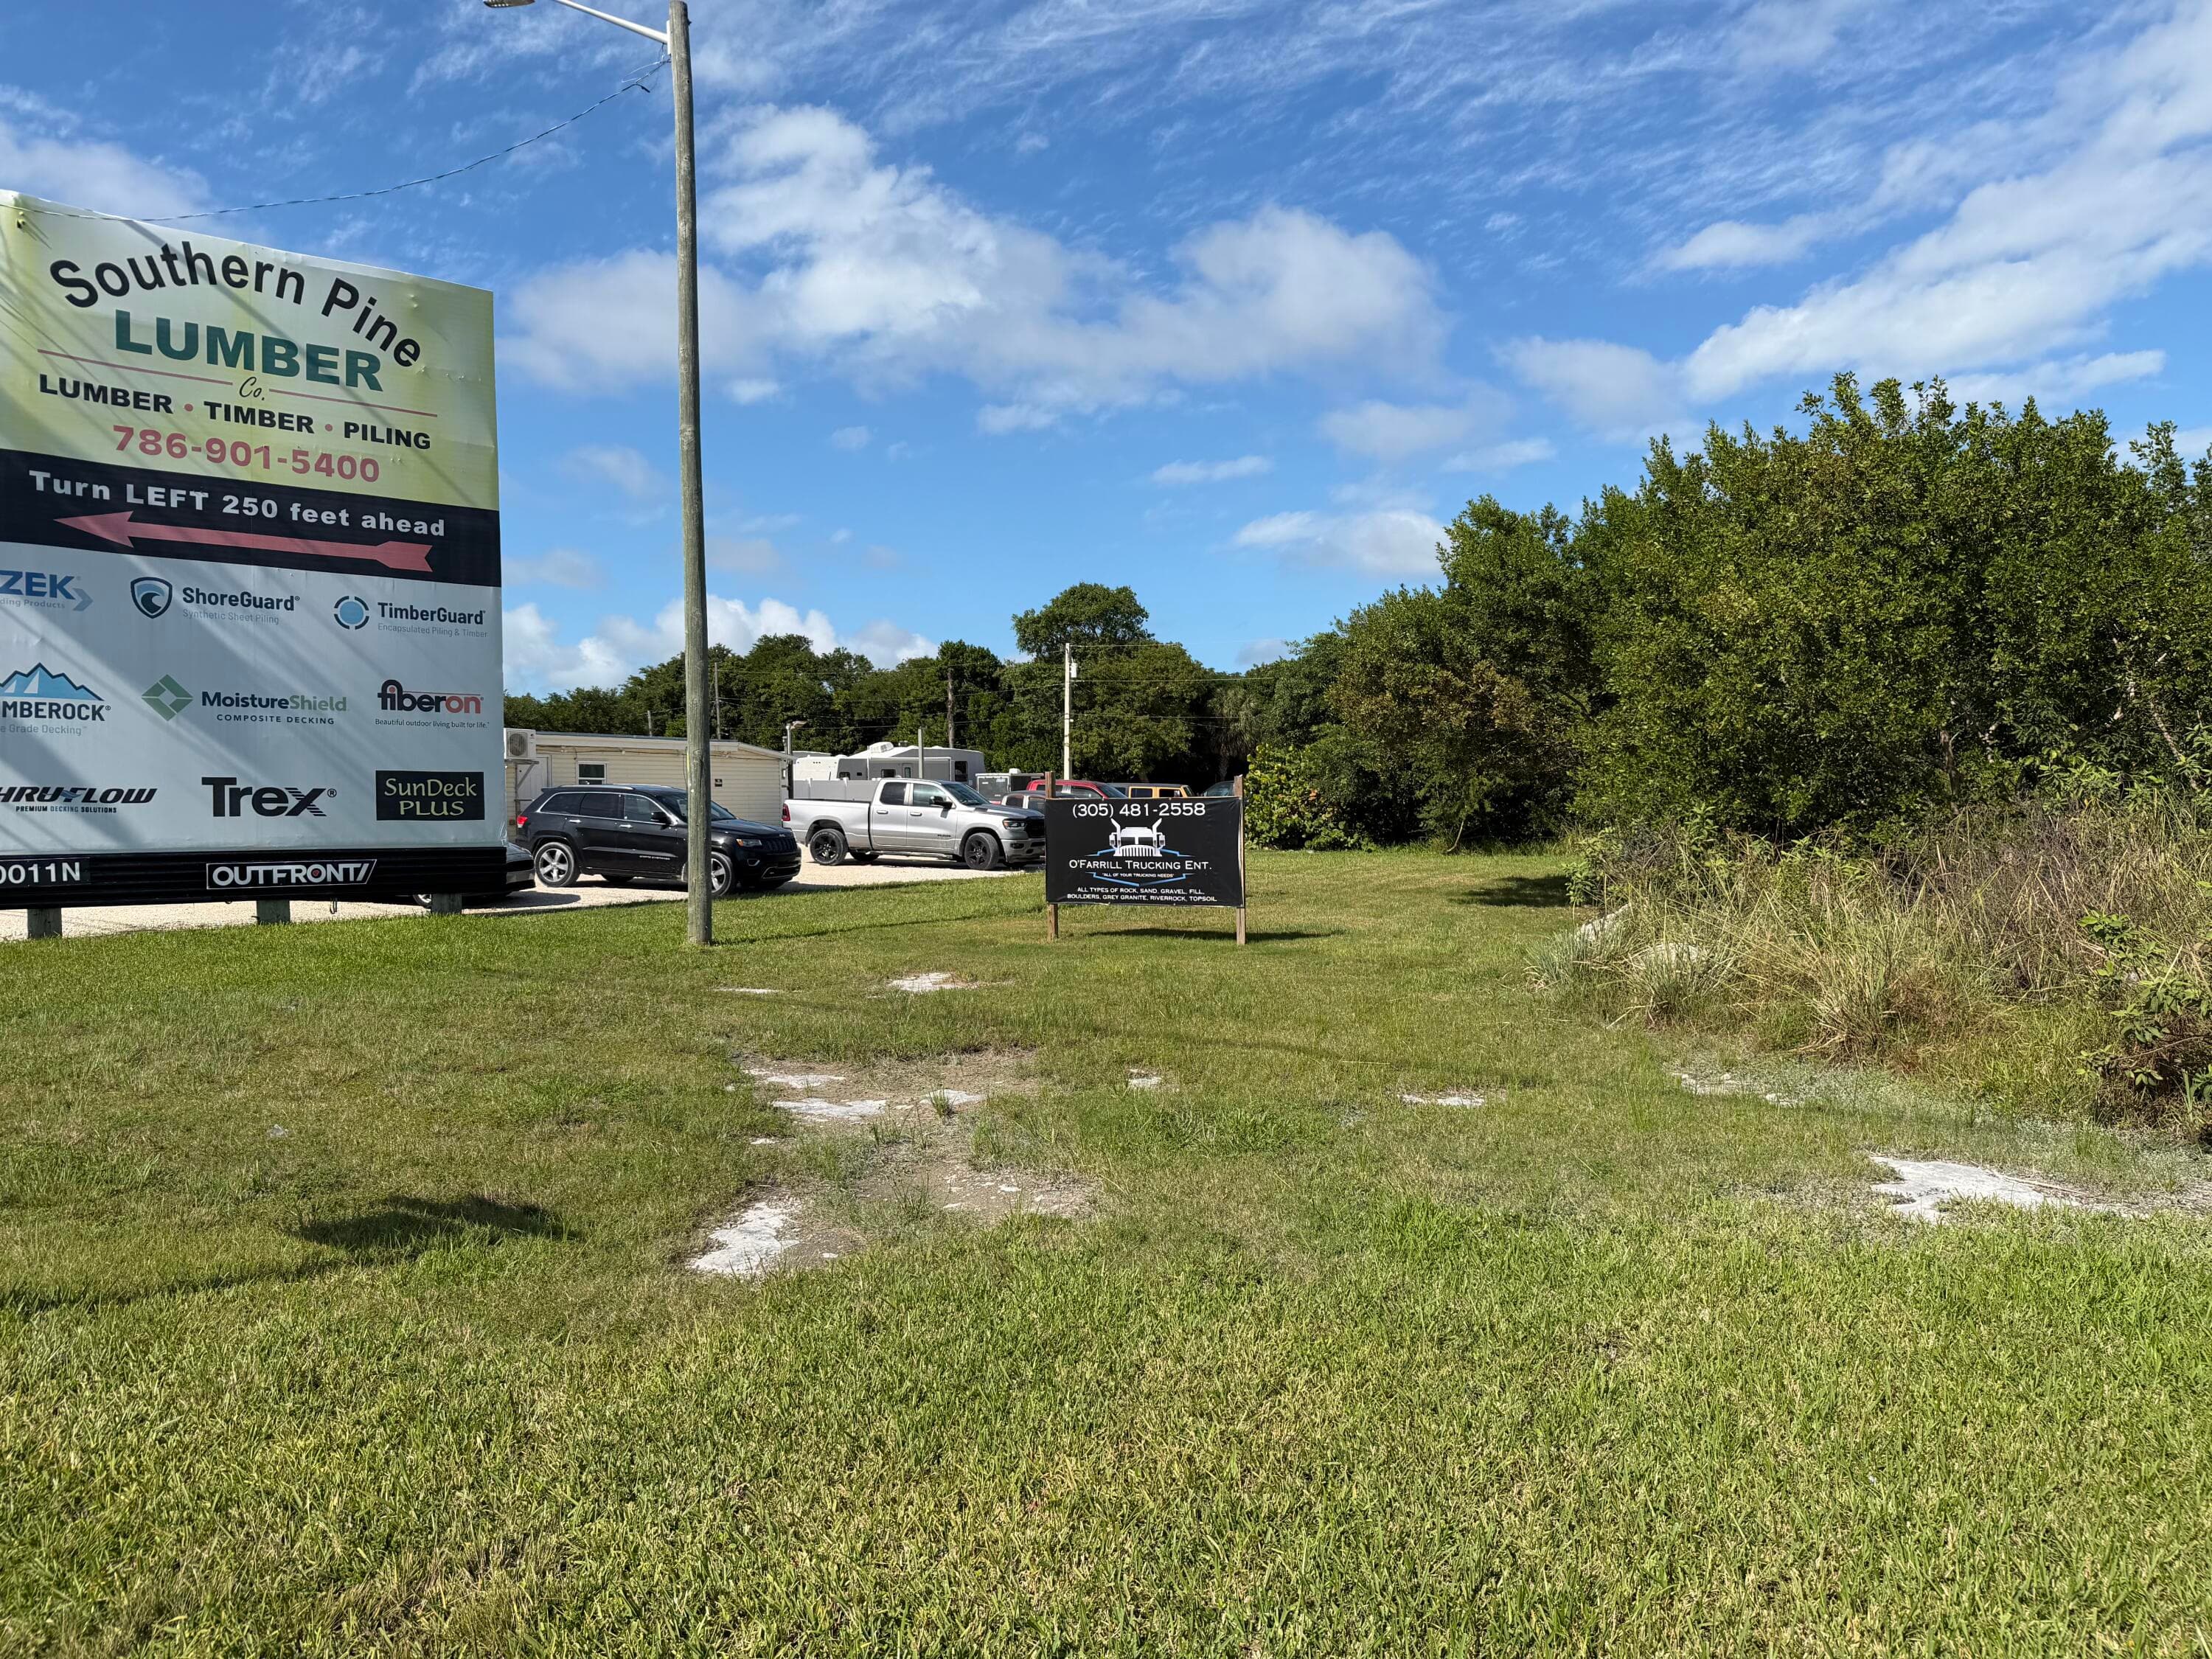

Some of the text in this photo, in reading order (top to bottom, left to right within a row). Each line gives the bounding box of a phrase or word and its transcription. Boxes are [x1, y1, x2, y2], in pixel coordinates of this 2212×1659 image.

[50, 241, 421, 366] Southern Pine
[115, 310, 383, 392] LUMBER
[239, 376, 265, 401] Co.
[39, 374, 431, 450] LUMBER TIMBER PILING
[113, 425, 380, 483] 786-901-5400
[29, 470, 445, 537] Turn LEFT 250 feet ahead
[24, 599, 66, 609] Products
[182, 609, 279, 625] Synthetic Sheet Piling
[378, 623, 430, 634] Encapsulated
[432, 627, 453, 638] Piling
[462, 628, 487, 638] Timber
[202, 691, 347, 712] MoistureShield
[217, 714, 335, 725] COMPOSITE DECKING
[375, 718, 405, 726] Beautiful
[433, 720, 450, 728] living
[9, 723, 38, 734] Grade
[384, 778, 477, 797] SunDeck
[399, 800, 465, 816] PLUS
[1072, 802, 1206, 818] (305) 481-2558
